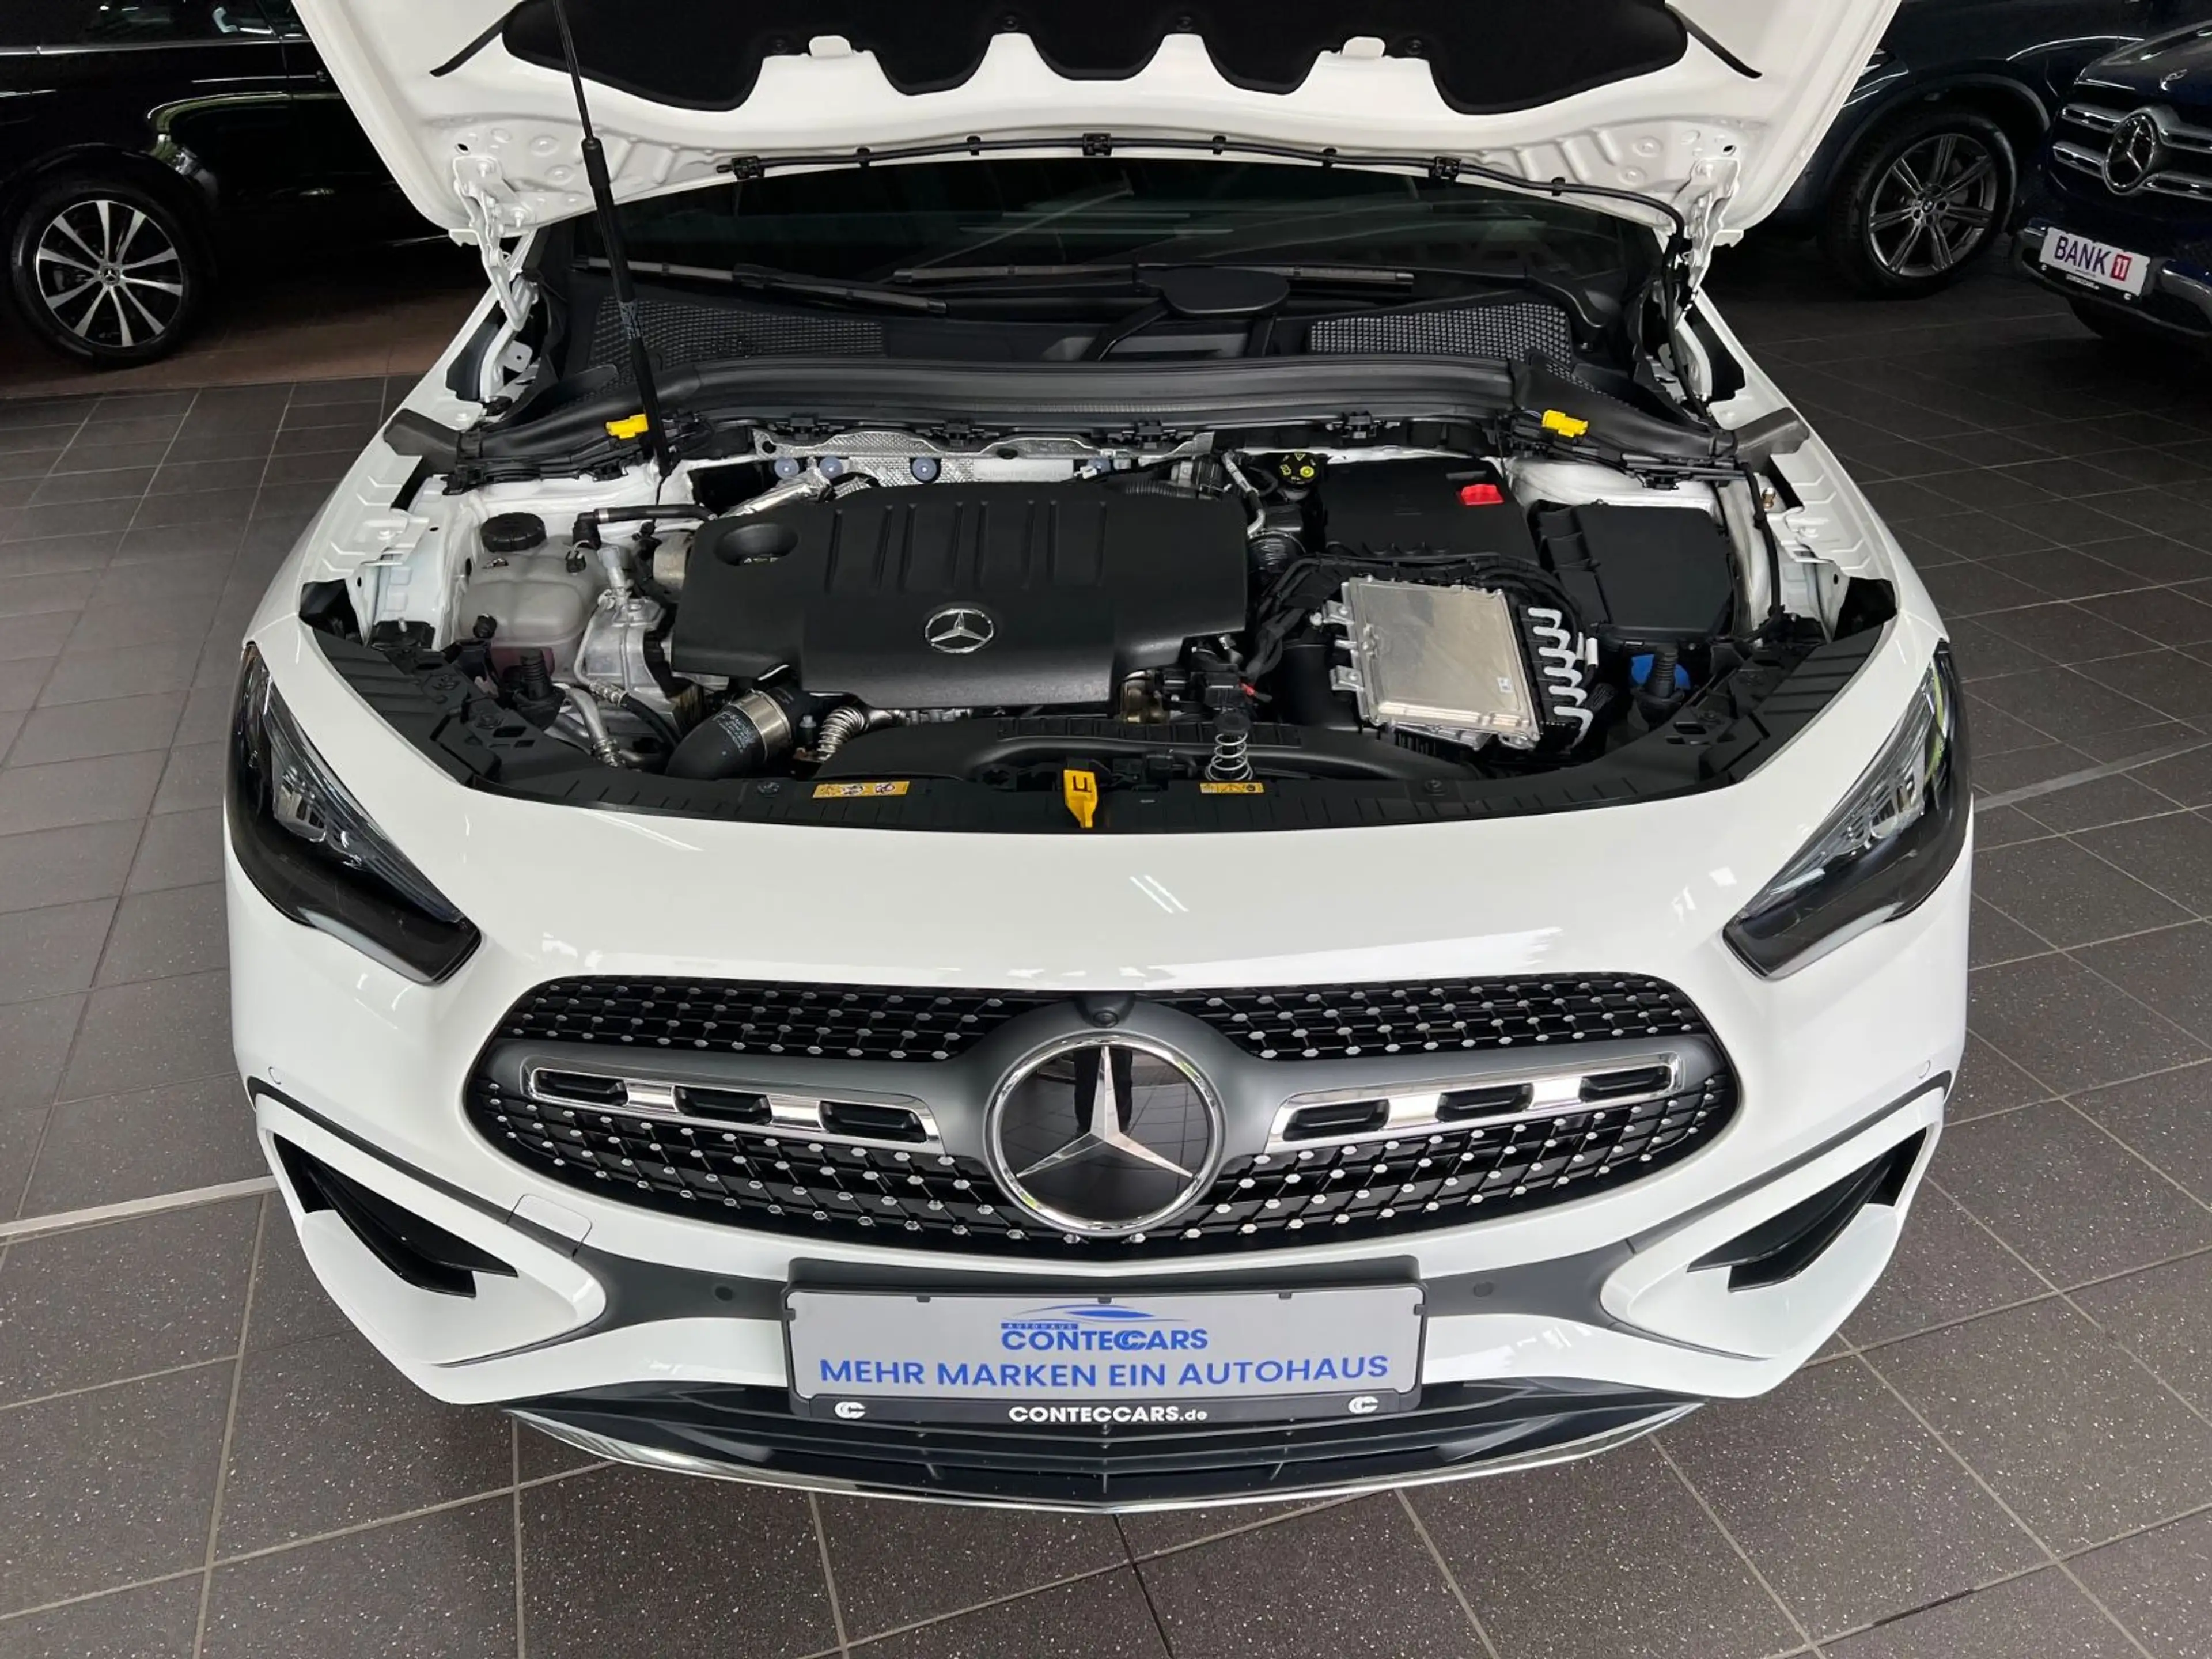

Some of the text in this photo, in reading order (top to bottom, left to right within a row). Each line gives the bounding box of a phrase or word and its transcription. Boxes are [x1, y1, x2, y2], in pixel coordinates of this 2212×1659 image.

[2054, 236, 2111, 275] BANK
[820, 1356, 1388, 1387] MEHR MARKEN EIN AUTOHAUS
[1009, 1406, 1207, 1423] CONTECCARS.de
